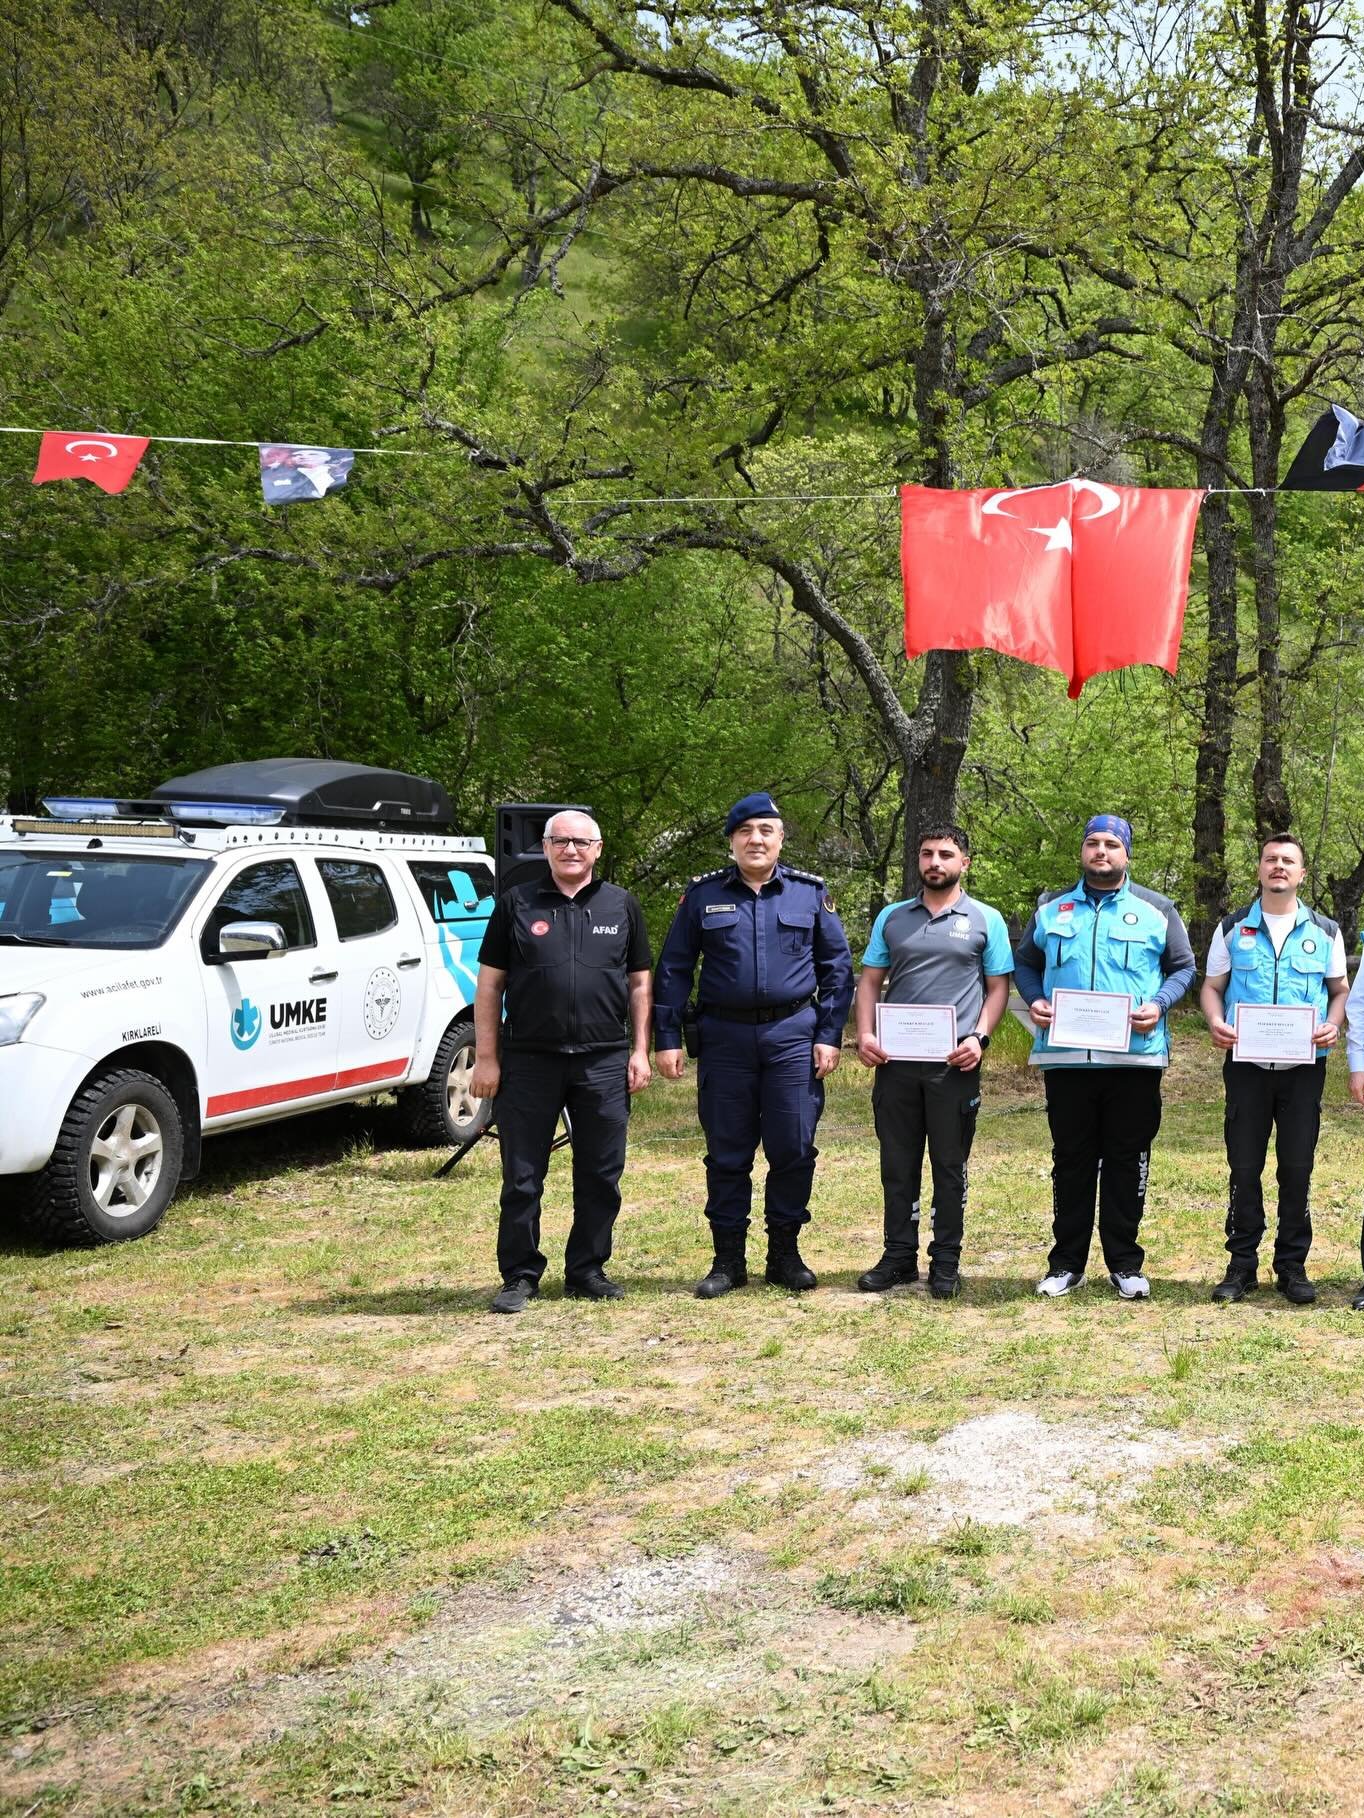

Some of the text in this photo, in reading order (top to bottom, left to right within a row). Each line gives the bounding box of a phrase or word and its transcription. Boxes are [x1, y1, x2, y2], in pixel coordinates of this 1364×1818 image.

[592, 924, 619, 935] AFAD
[80, 976, 163, 999] www.acilafet.gov.tr
[270, 997, 327, 1030] UMKE
[121, 1021, 162, 1042] KIRKLARELİ
[1138, 1151, 1148, 1197] UMKE
